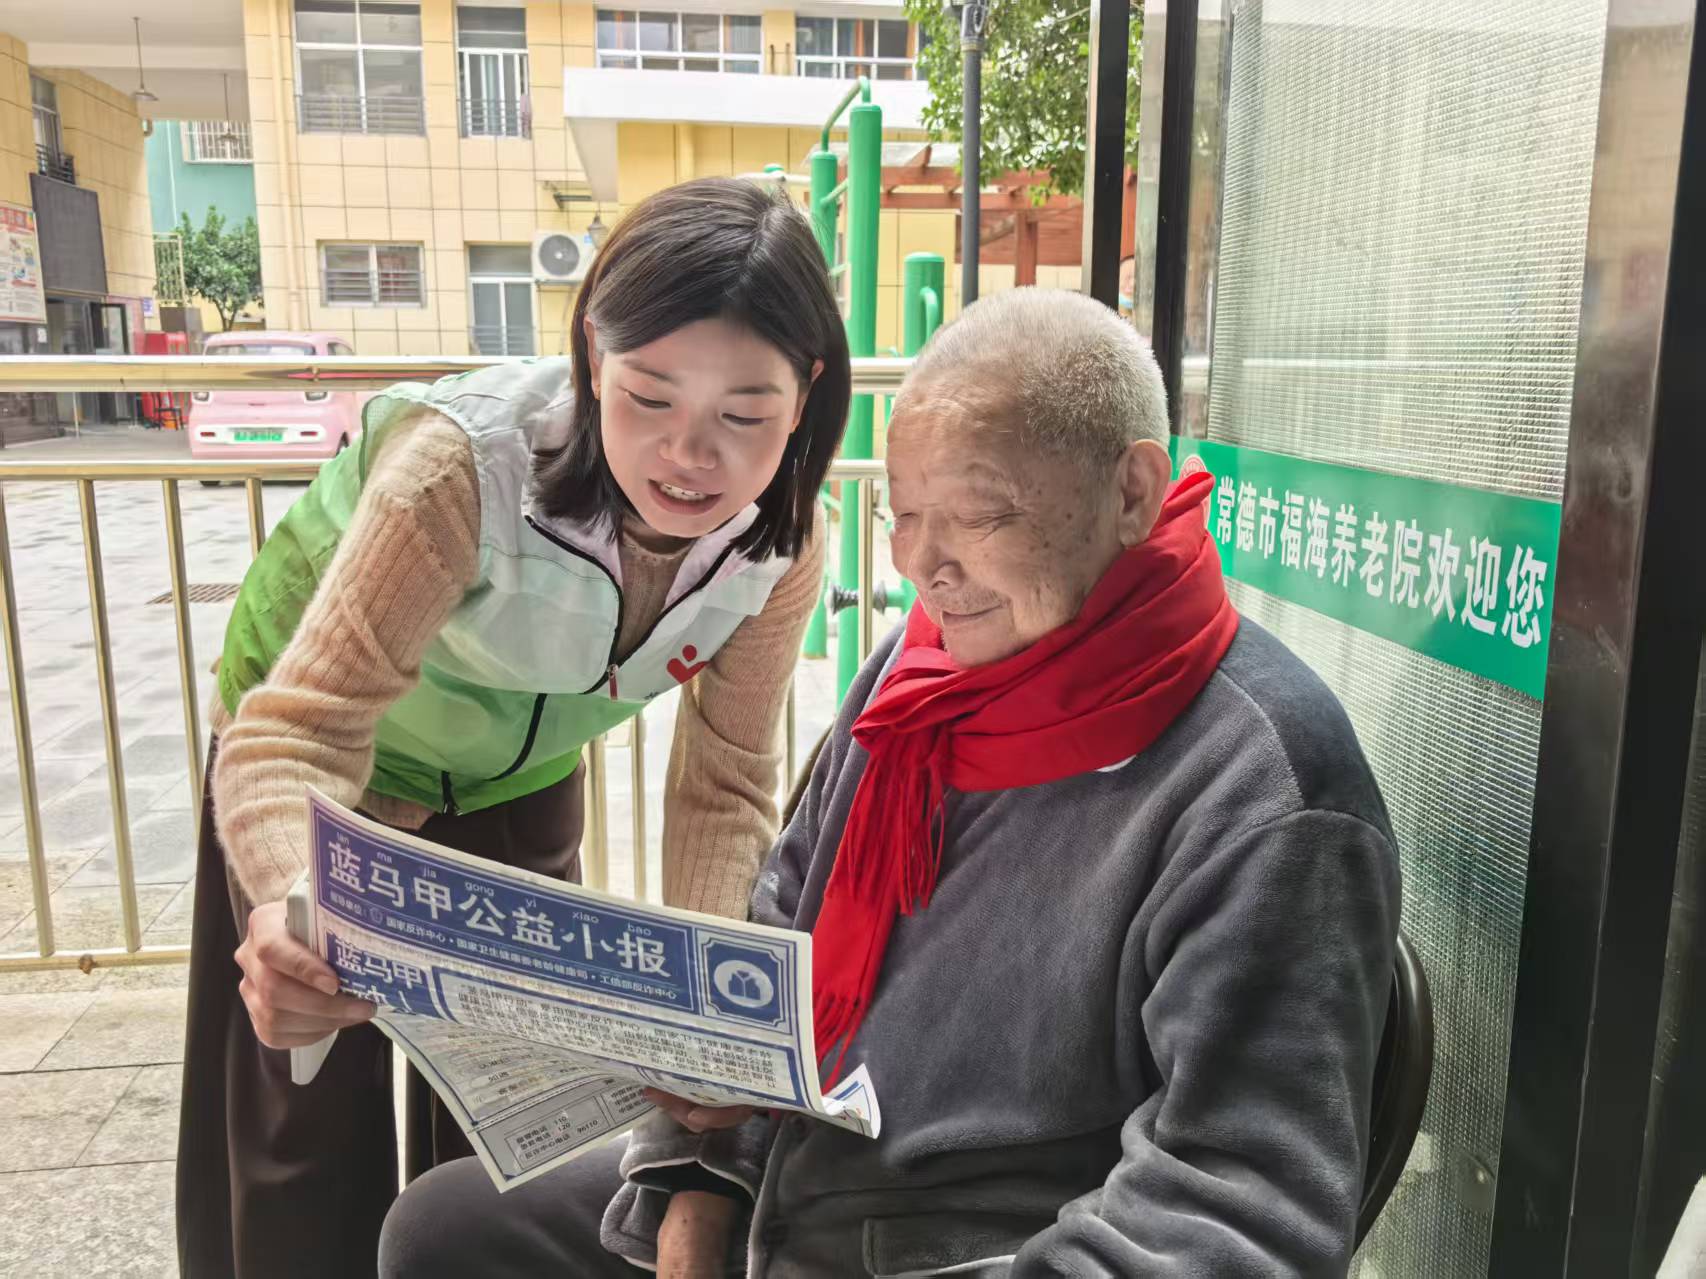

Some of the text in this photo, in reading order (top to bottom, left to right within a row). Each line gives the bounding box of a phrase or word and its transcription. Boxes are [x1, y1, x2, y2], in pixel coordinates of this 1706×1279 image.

[1216, 476, 1548, 649] 常德市福海养老院欢迎您
[328, 840, 671, 978] 蓝马甲公益小报
[464, 880, 495, 898] gong
[572, 911, 599, 925] xiao
[628, 922, 652, 936] bao
[335, 938, 423, 990] 蓝马甲
